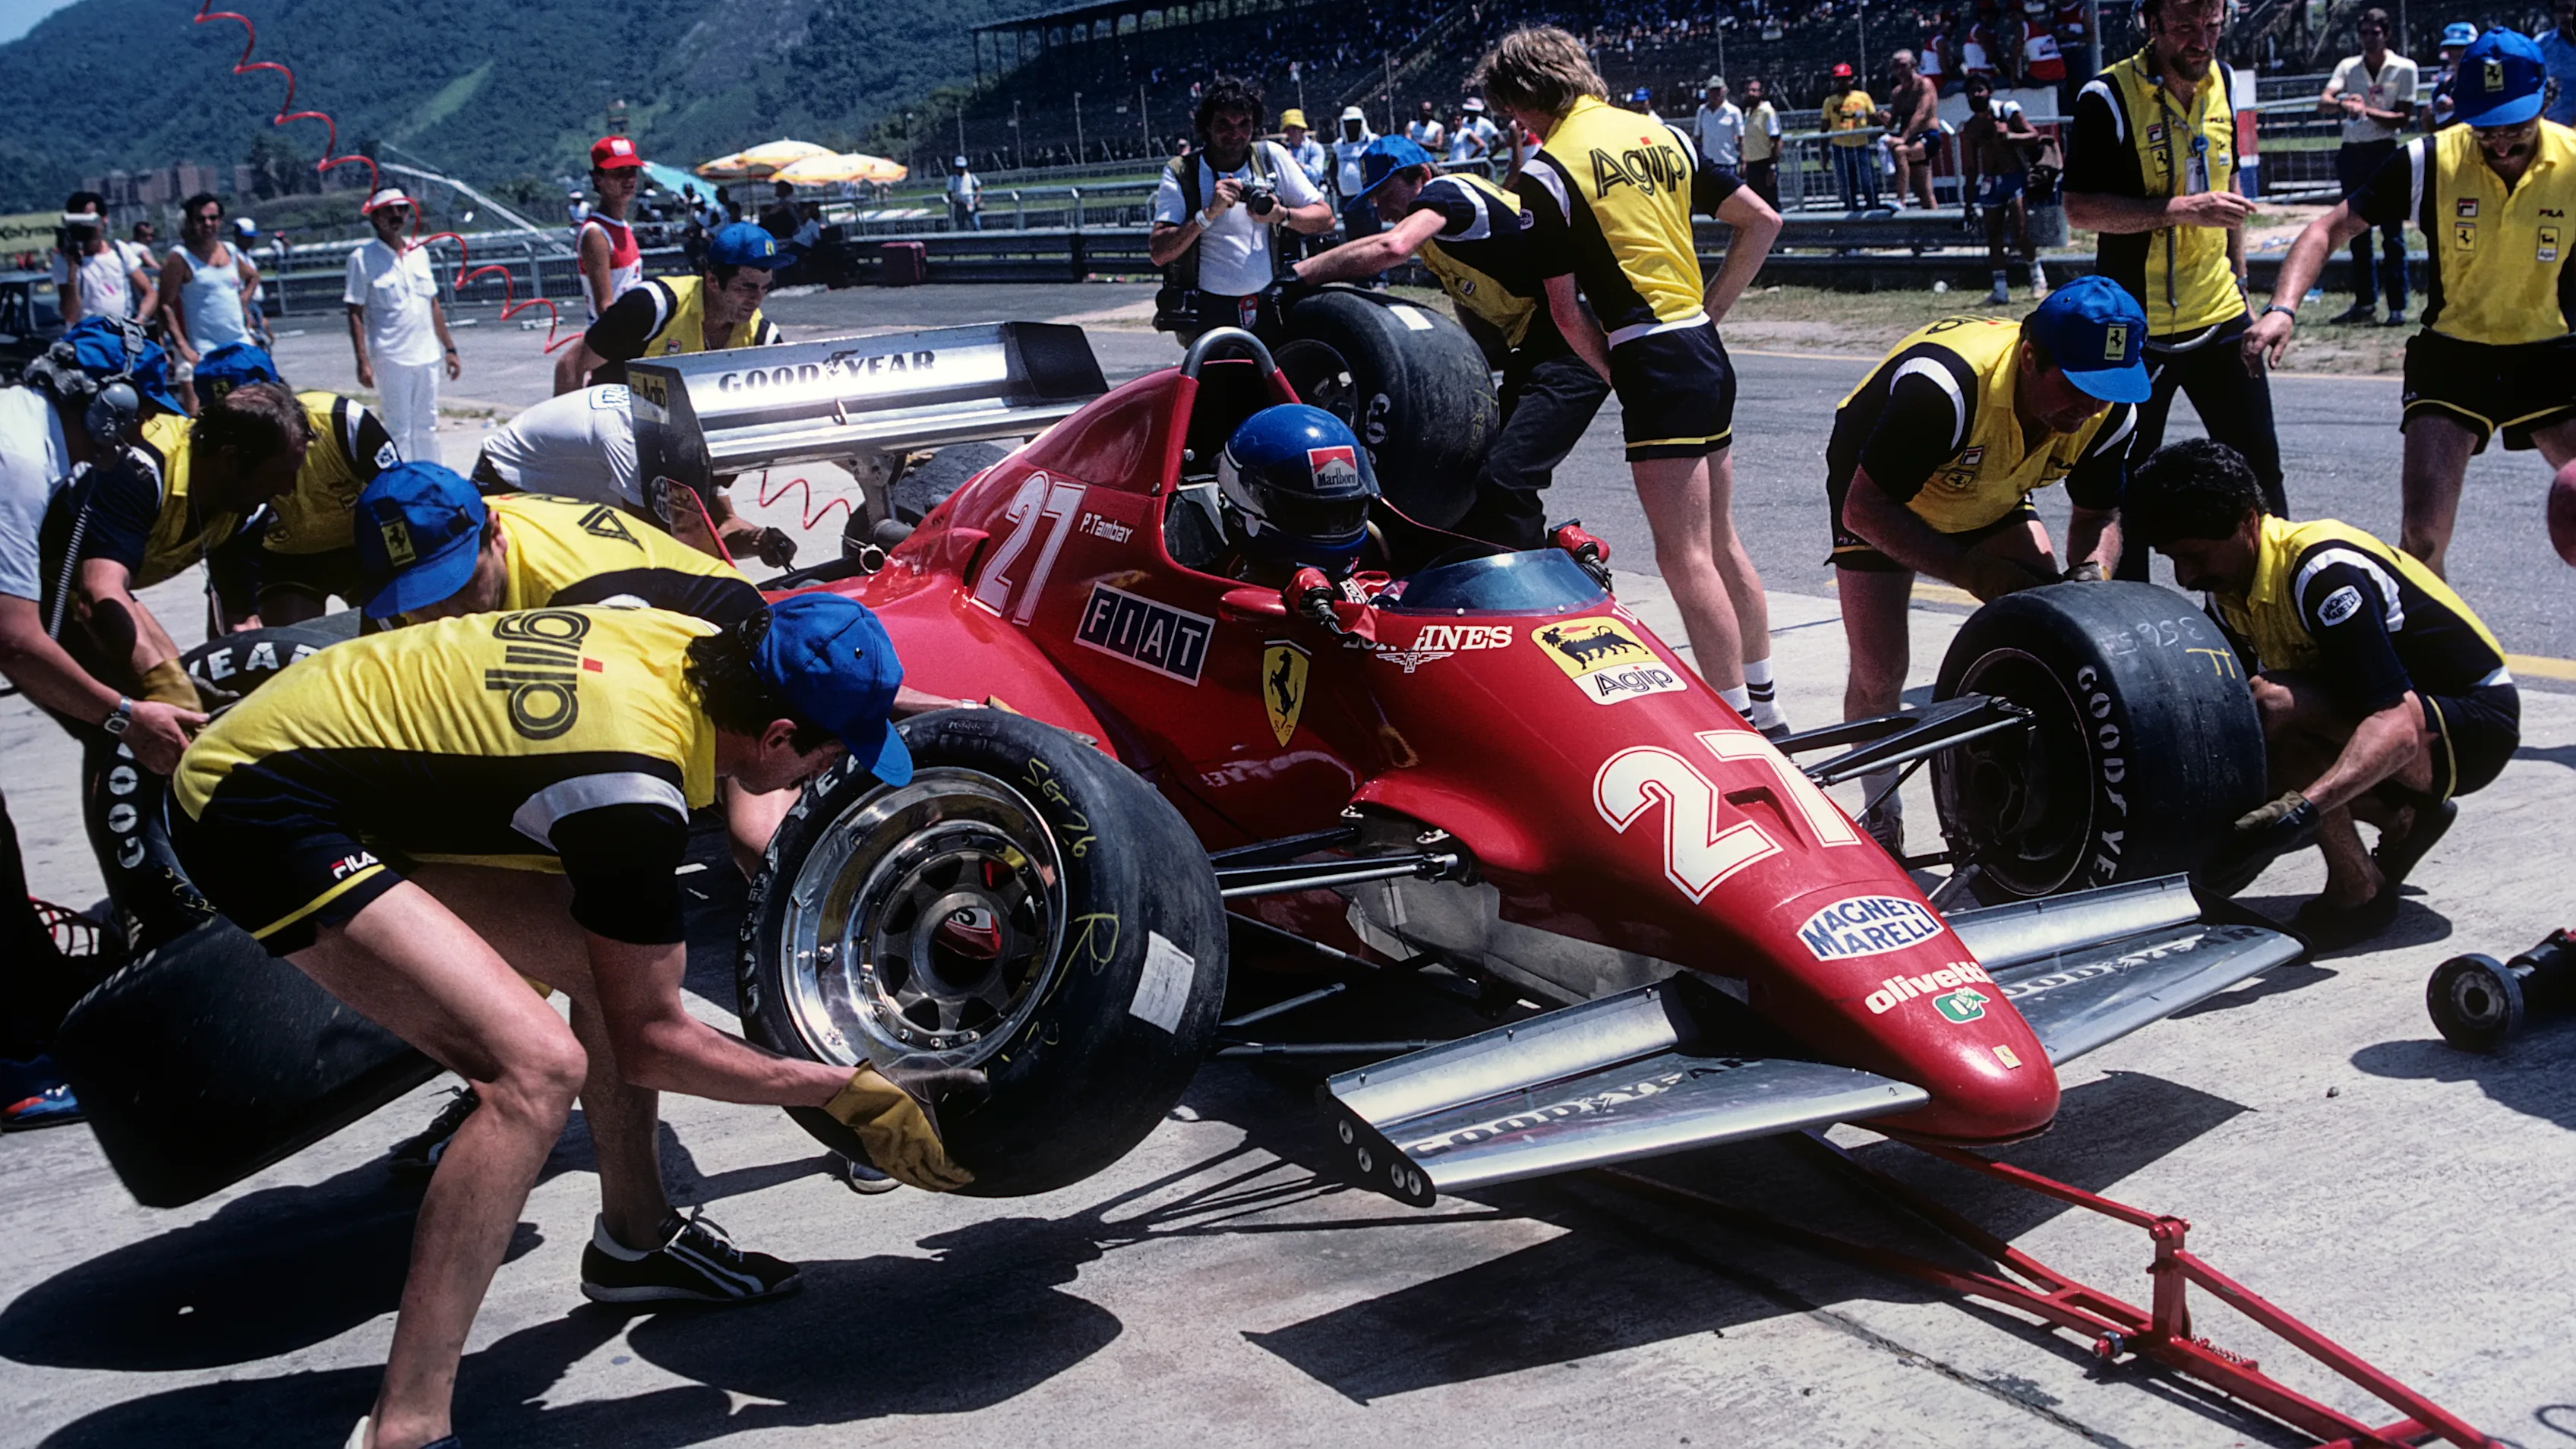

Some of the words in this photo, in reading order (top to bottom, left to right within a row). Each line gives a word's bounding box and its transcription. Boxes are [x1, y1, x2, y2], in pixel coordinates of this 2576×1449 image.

[1589, 136, 1687, 200] Agip
[2539, 208, 2565, 218] FILA
[1317, 467, 1356, 487] Marlboro
[970, 470, 1087, 627] 27
[1087, 597, 1202, 668] FIAT
[485, 606, 639, 741] gip
[1594, 665, 1673, 697] Agip
[1022, 757, 1071, 807] SET
[1593, 729, 1862, 905] 27
[330, 851, 379, 880] FILA
[1802, 898, 1939, 946] MAGNETI
[1802, 911, 1939, 957] MARELLI
[1865, 961, 1994, 1015] olivetti
